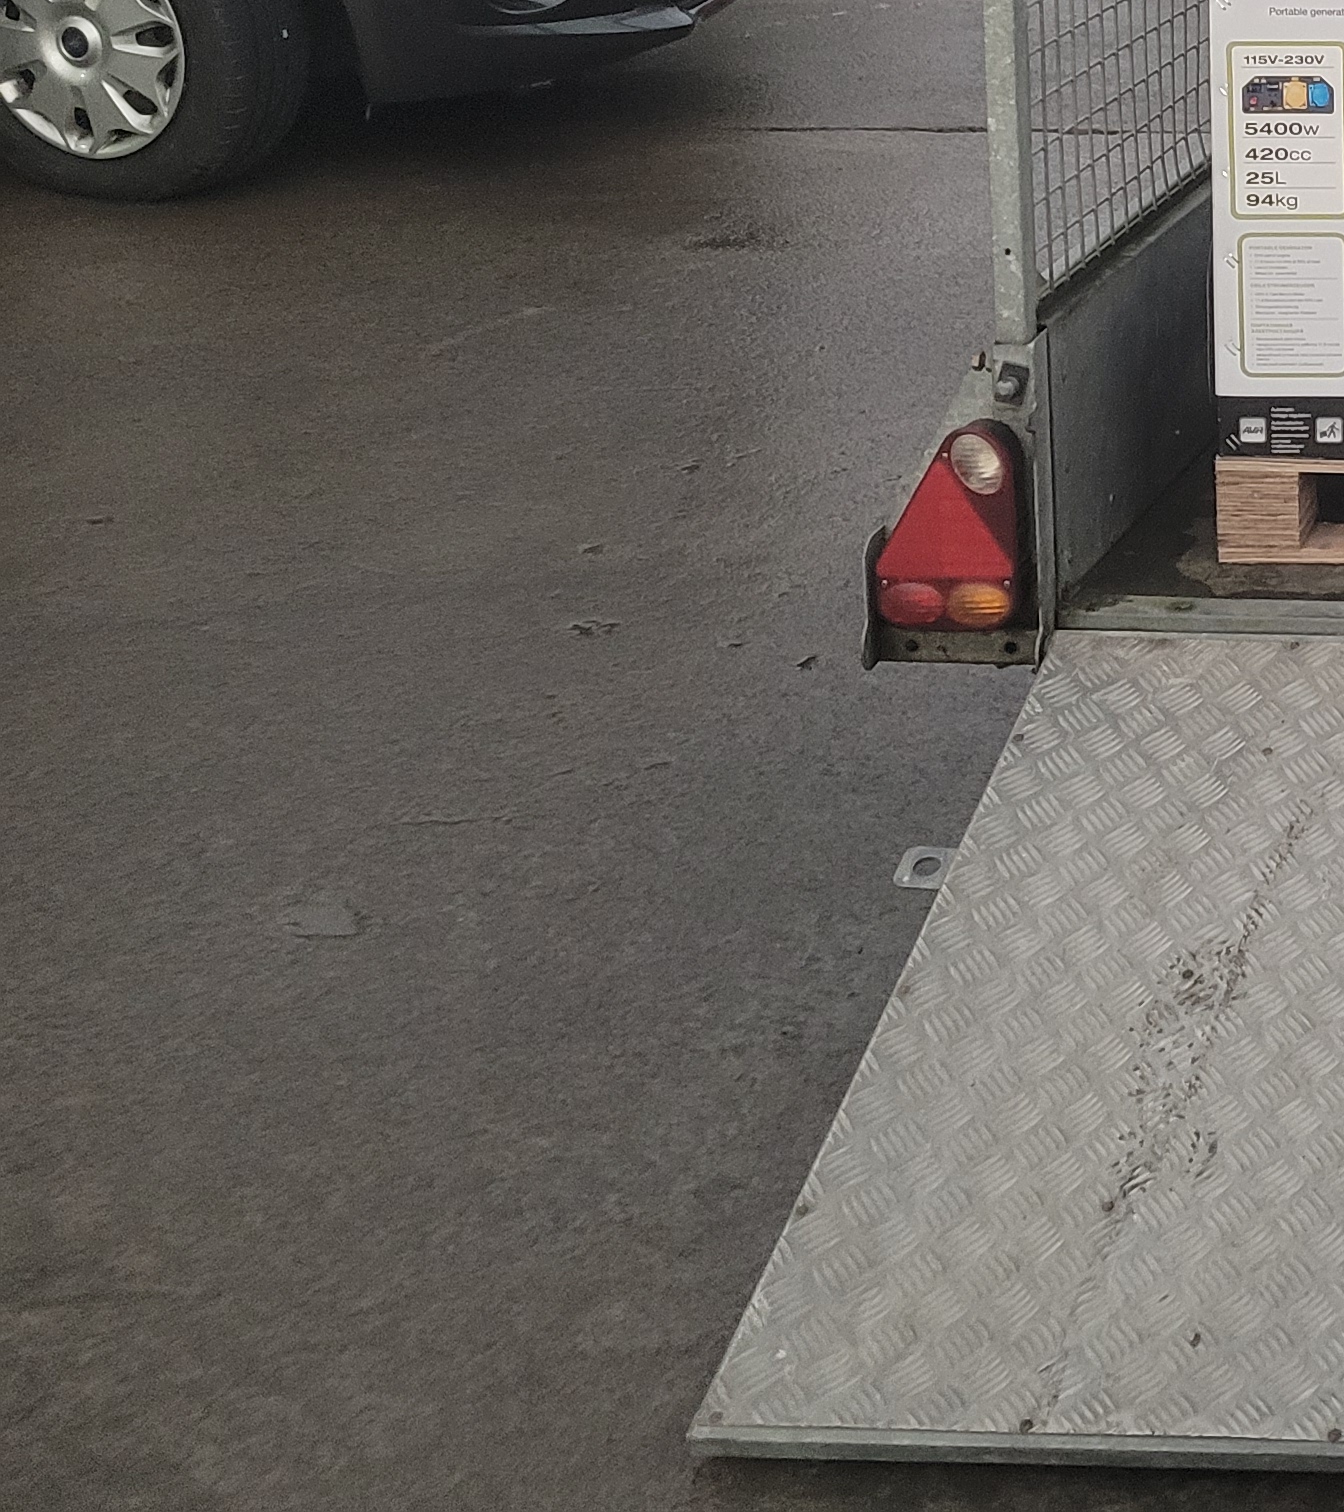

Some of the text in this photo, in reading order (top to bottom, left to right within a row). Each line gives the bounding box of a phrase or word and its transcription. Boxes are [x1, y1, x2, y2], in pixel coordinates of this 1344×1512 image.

[1268, 6, 1308, 17] Portable
[1243, 53, 1325, 66] 115V-230V
[1244, 147, 1312, 162] 420cc
[1244, 171, 1287, 186] 25L
[1245, 192, 1299, 210] 94kg
